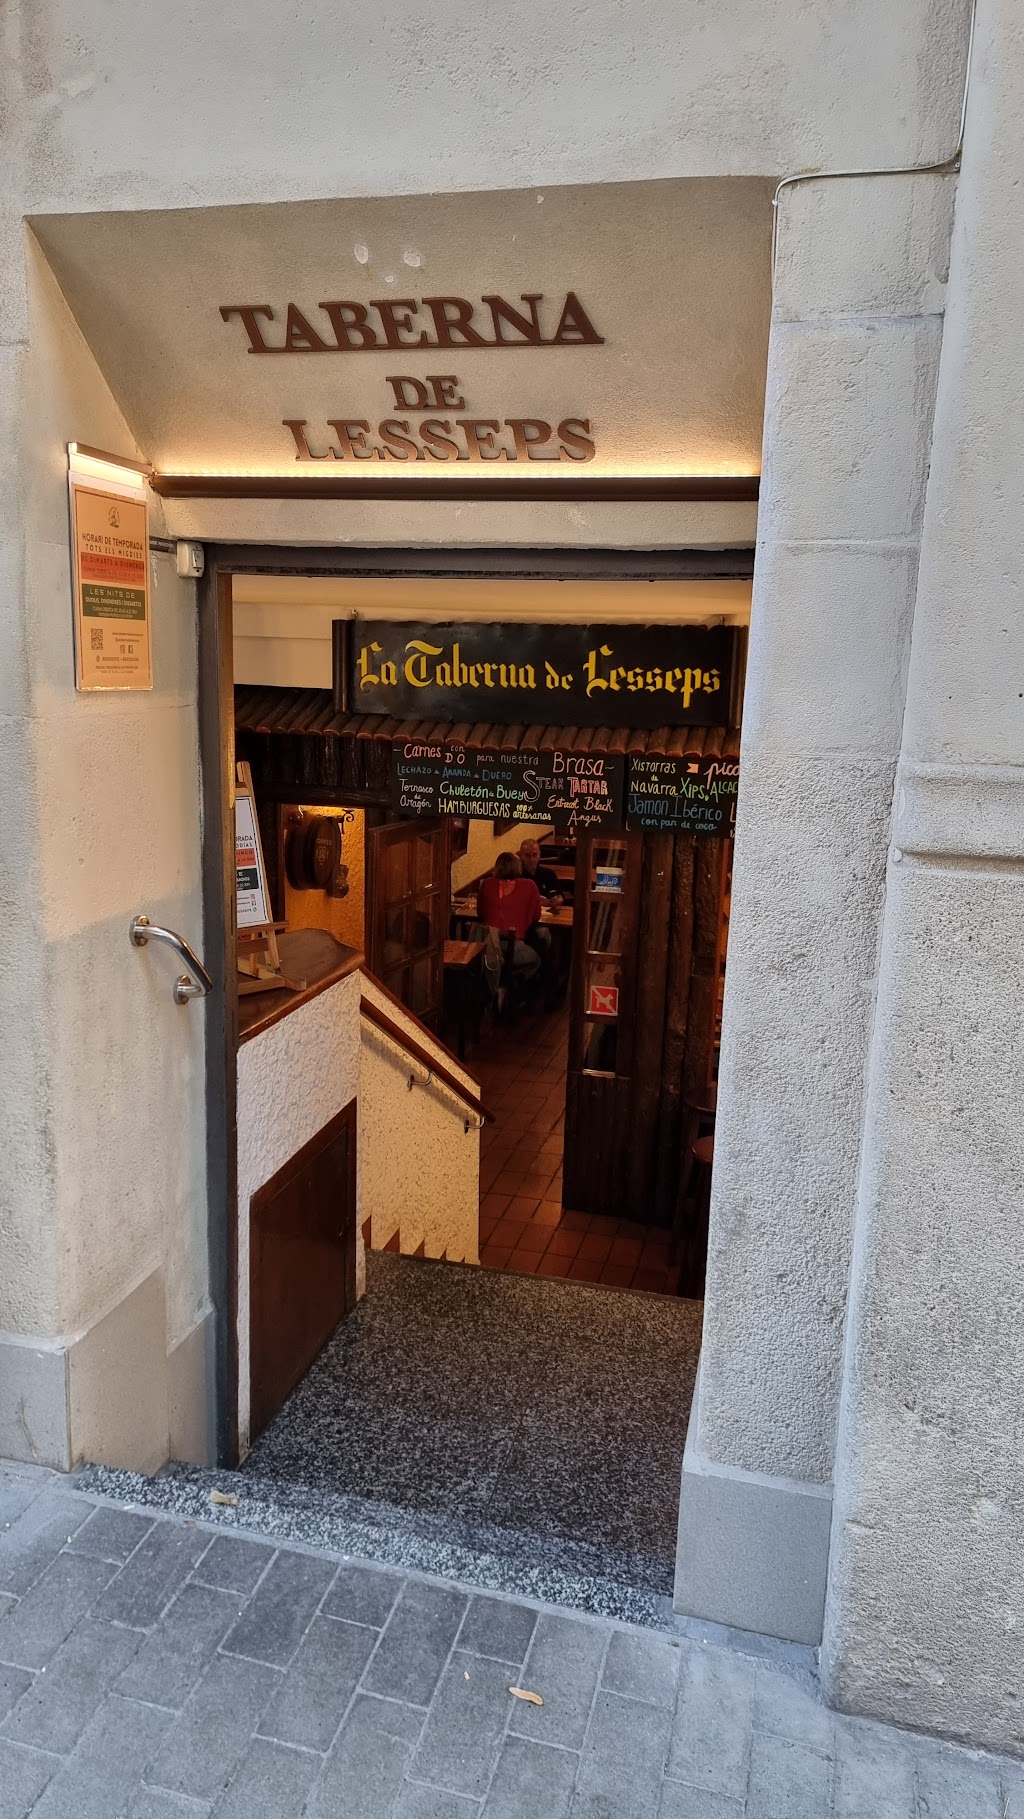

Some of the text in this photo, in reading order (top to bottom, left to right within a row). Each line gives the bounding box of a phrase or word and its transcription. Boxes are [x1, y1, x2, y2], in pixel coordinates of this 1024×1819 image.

[219, 291, 605, 354] TABERNA
[386, 375, 465, 410] DE
[282, 419, 596, 463] LESSEPS
[82, 533, 103, 544] HORARI
[105, 536, 111, 545] DE
[113, 538, 143, 550] TEMPORADA
[86, 544, 101, 552] TOTS
[119, 550, 142, 559] MIGDIES
[357, 640, 720, 708] La Taberna de Lesseps
[404, 744, 441, 758] Carnes
[476, 754, 494, 766] para
[500, 754, 539, 765] nuestra
[553, 752, 604, 776] Brasa
[397, 763, 432, 775] LECHAZO
[442, 766, 471, 778] ARANDA
[482, 769, 512, 781] DUERO
[399, 778, 433, 793] Ternasco
[440, 781, 488, 798] Chuletón
[496, 785, 525, 800] Buey
[631, 780, 678, 795] Navarra
[438, 798, 510, 818] HAMBURGUESAS
[670, 796, 722, 820] Ibérico
[567, 810, 601, 827] Angus
[661, 819, 677, 829] pan
